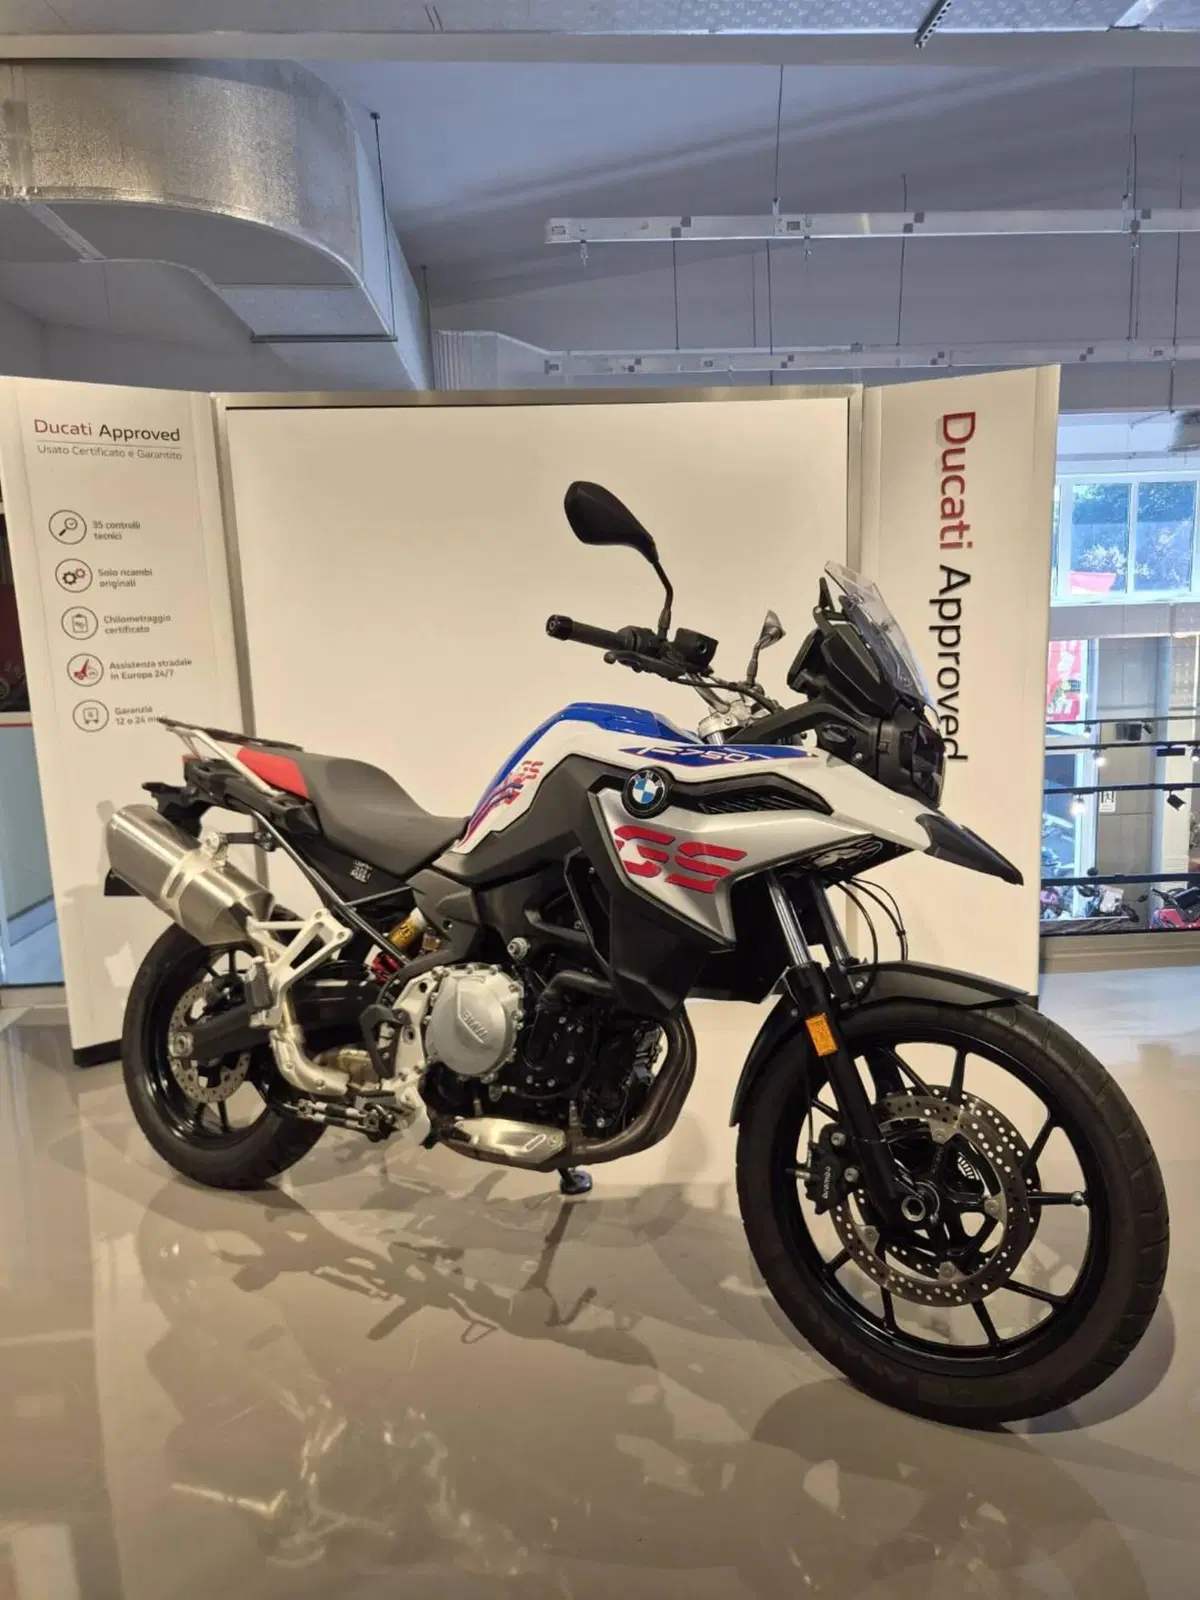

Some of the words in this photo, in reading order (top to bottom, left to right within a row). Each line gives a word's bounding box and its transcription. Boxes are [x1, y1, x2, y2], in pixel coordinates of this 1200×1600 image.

[34, 418, 92, 436] Ducati
[99, 423, 181, 442] Approved
[37, 444, 70, 455] Usato
[72, 446, 126, 458] Certificato
[128, 450, 134, 458] e
[136, 449, 183, 461] Garantito
[939, 411, 976, 550] Ducati
[92, 520, 104, 529] 35
[105, 520, 141, 530] controlli
[94, 532, 122, 540] tecnici
[98, 568, 119, 577] Solo
[120, 567, 153, 577] ricambi
[99, 579, 137, 590] originali
[103, 614, 171, 625] Chilometraggio
[104, 625, 150, 634] certificato
[109, 660, 156, 670] Assistenza
[158, 658, 192, 668] stradale
[929, 564, 971, 761] Approved
[110, 671, 119, 680] in
[121, 671, 153, 681] Europa
[155, 668, 174, 679] 24/7
[115, 717, 125, 725] 12
[633, 769, 664, 790] BMW
[614, 824, 747, 893] GS
[461, 1009, 489, 1041] BMW
